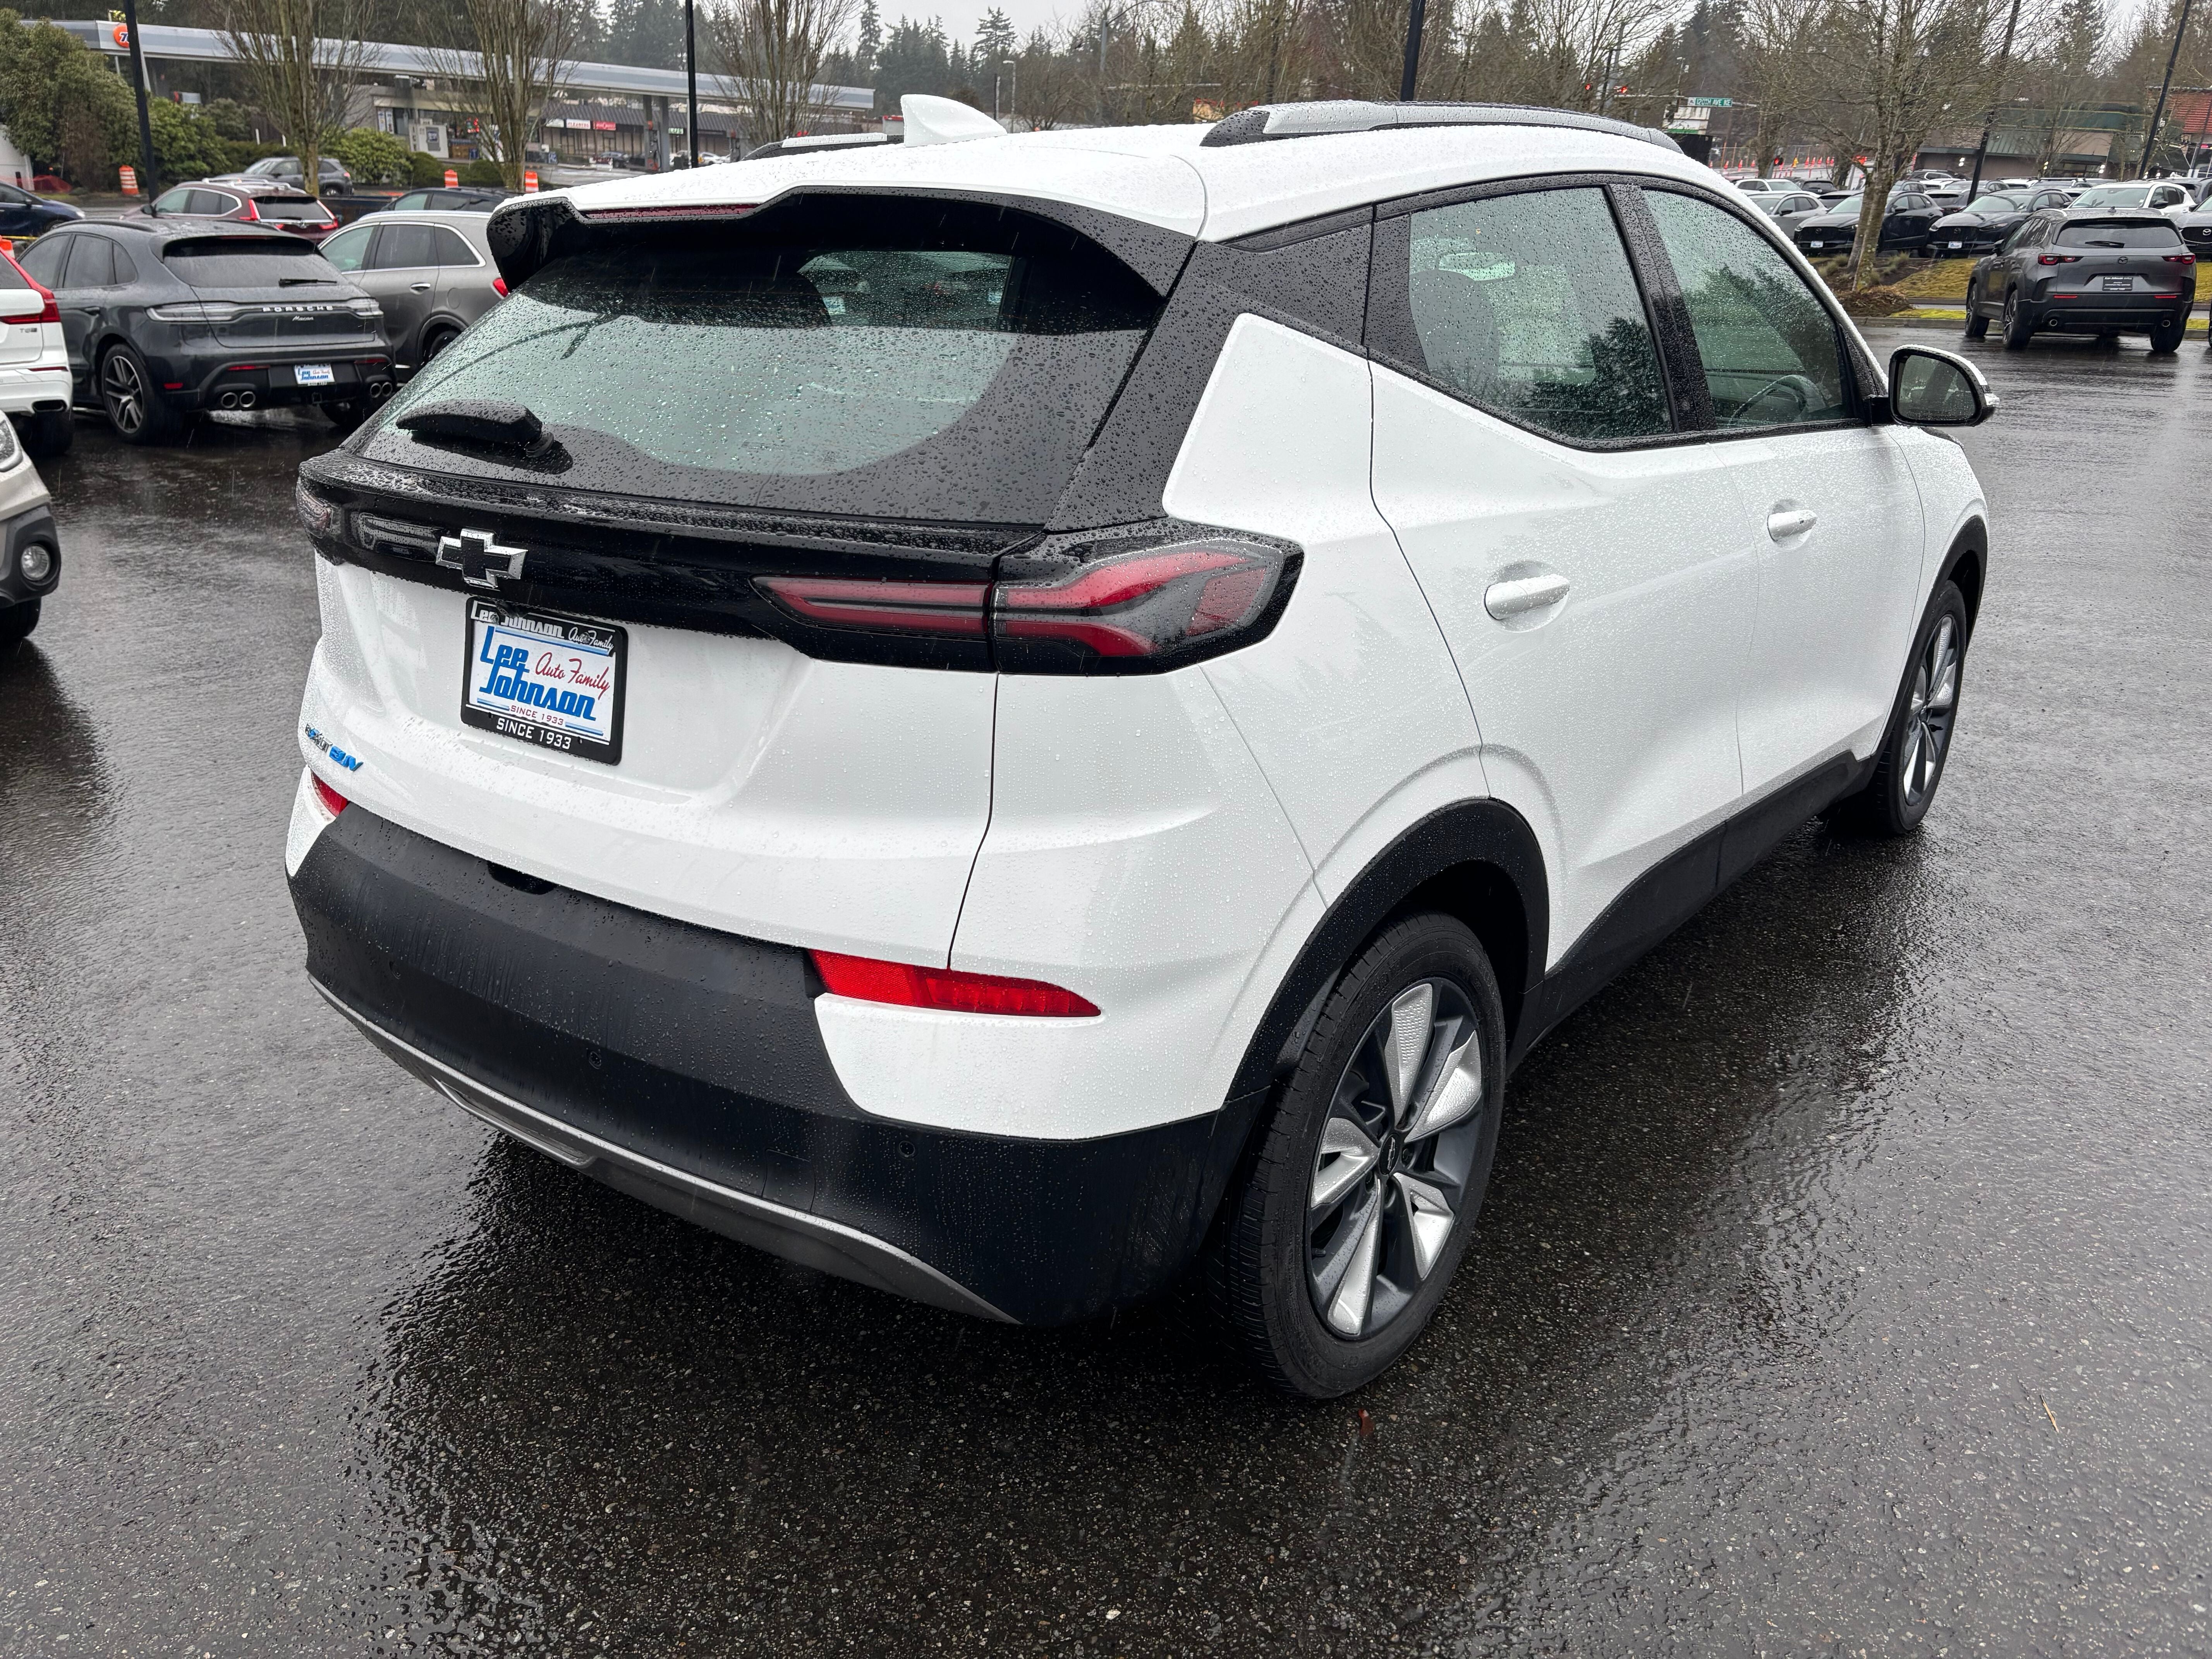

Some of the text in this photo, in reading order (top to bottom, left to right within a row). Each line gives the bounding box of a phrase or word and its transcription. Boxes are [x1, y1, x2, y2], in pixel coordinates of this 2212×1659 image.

[480, 625, 529, 669] Lee
[588, 630, 614, 655] Family
[479, 664, 596, 721] Johnson
[535, 652, 610, 701] Auto Family
[496, 717, 572, 750] SINCE 1933
[510, 705, 564, 725] SINCE 1933
